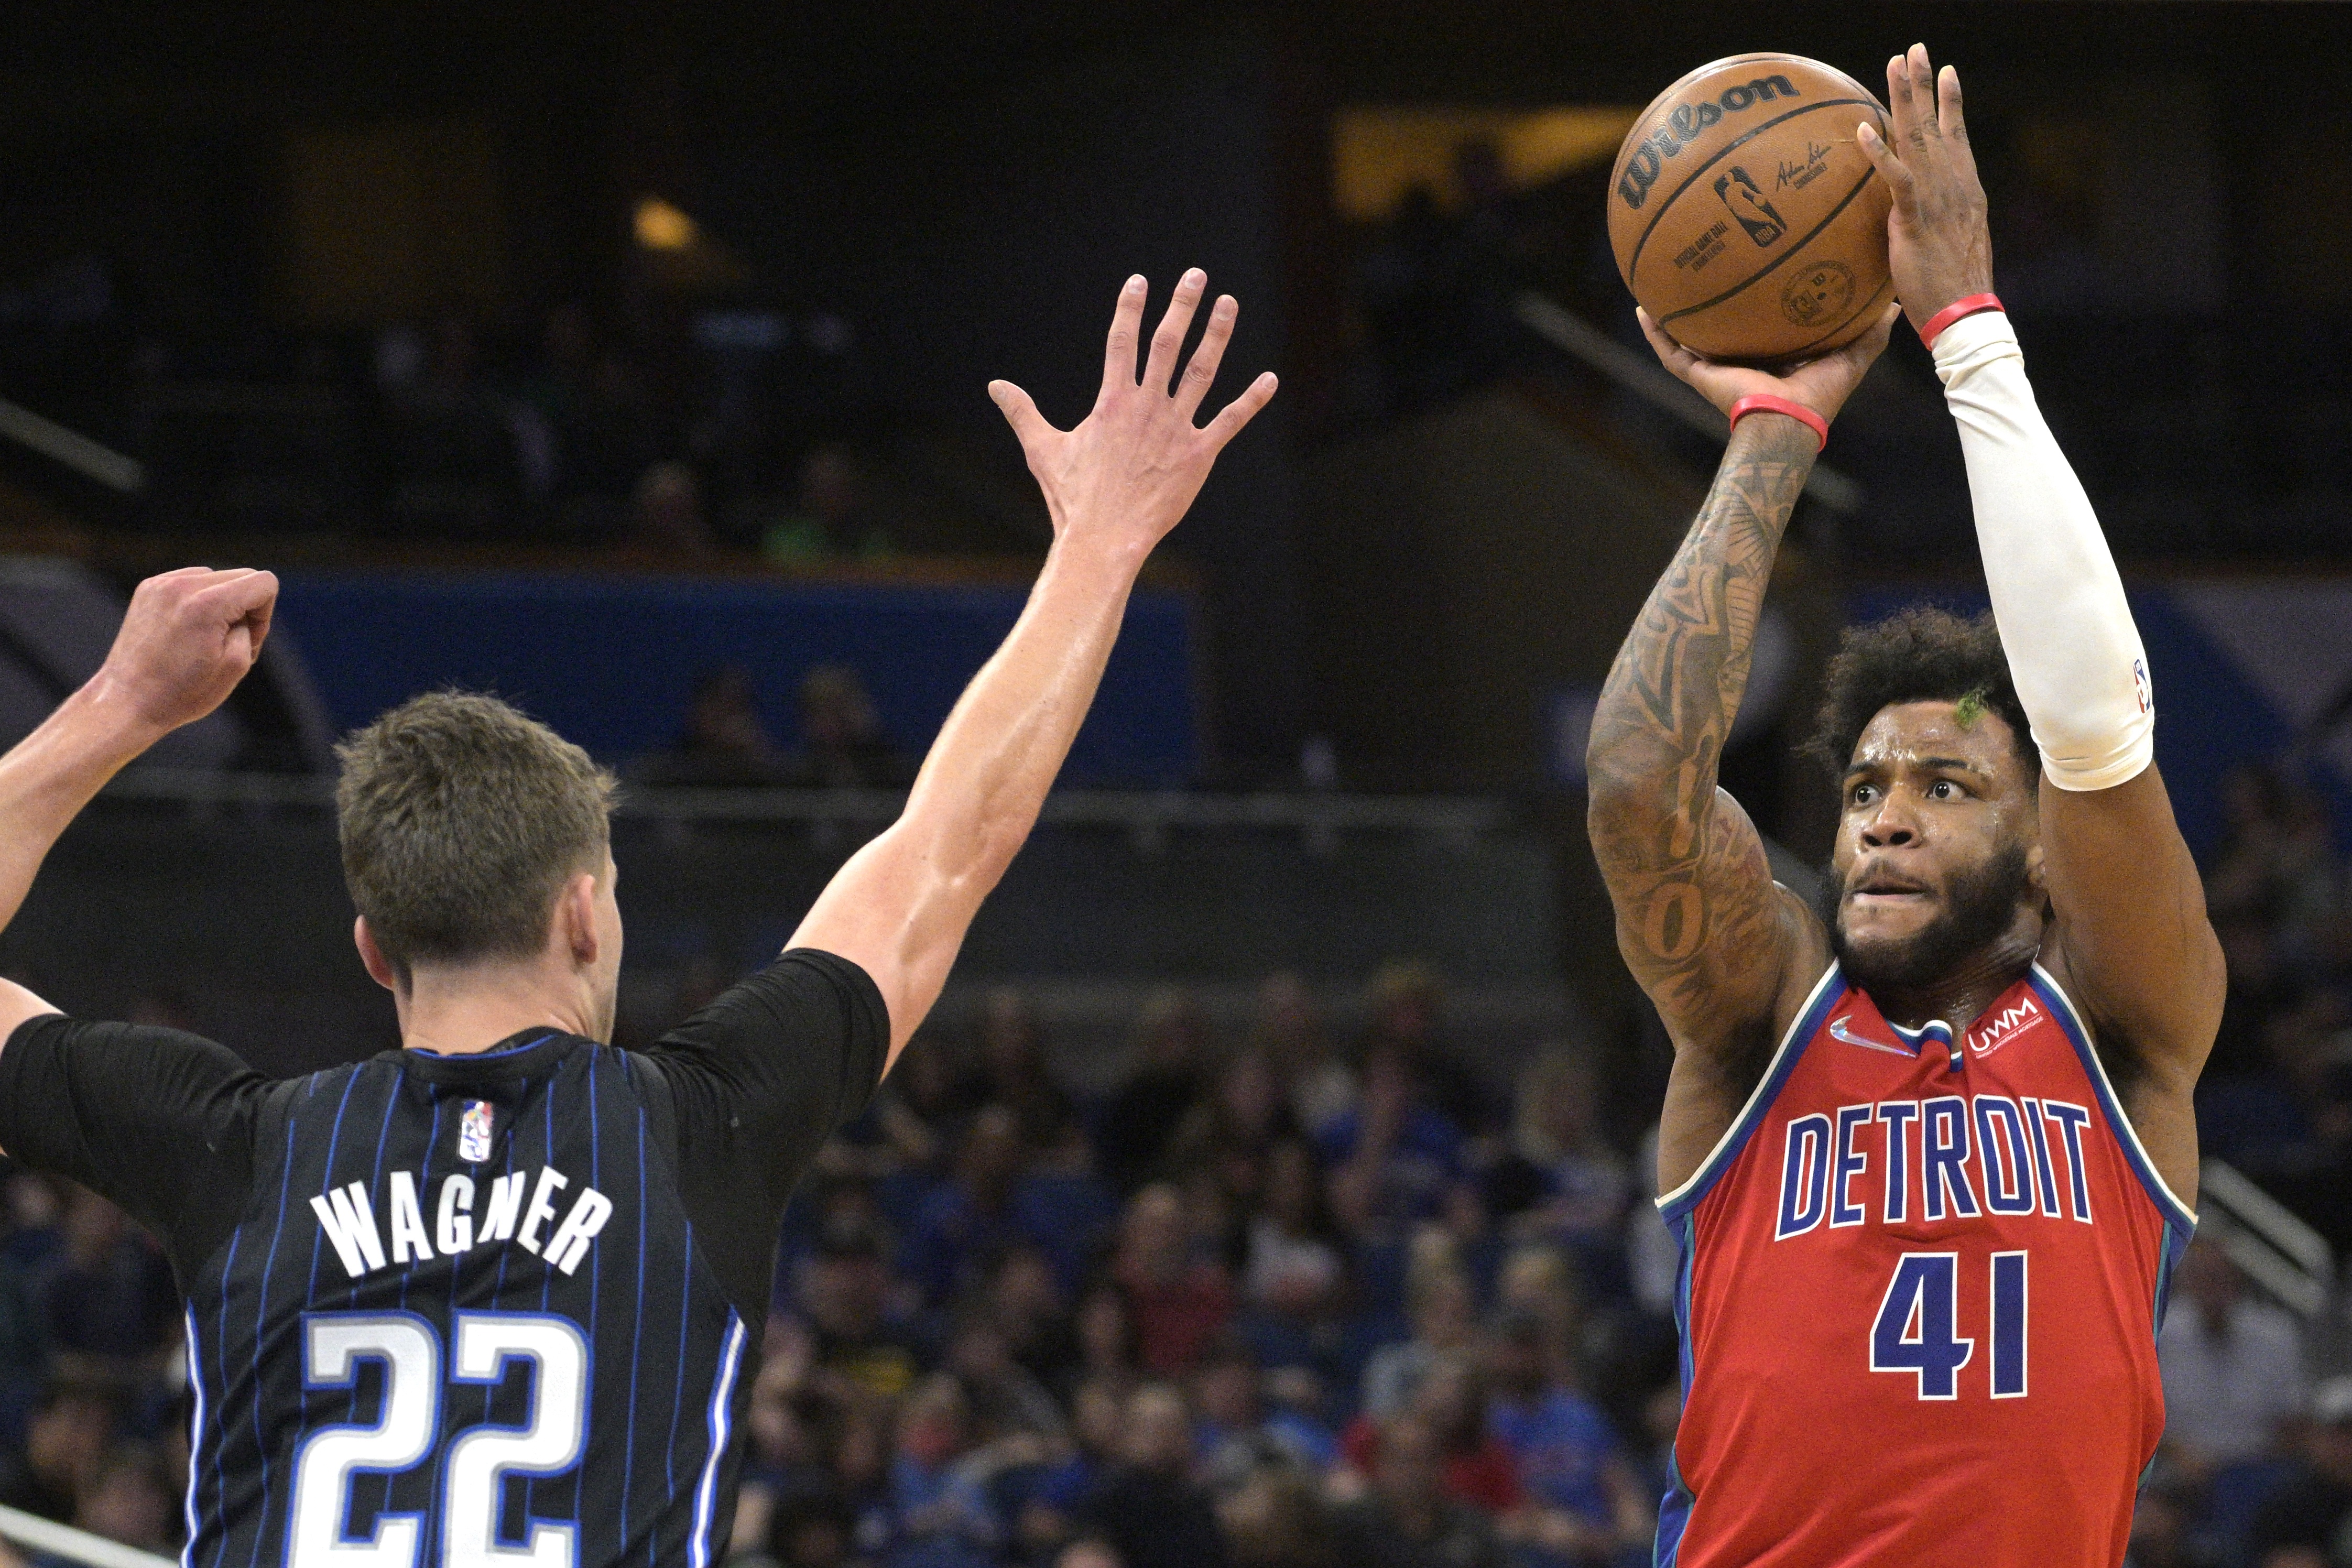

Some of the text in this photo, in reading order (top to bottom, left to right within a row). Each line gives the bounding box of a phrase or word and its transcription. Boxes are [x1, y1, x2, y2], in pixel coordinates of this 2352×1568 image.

[1618, 74, 1800, 209] Wilson
[1755, 225, 1777, 244] NBA
[1968, 997, 2038, 1052] UWM
[1976, 1016, 2043, 1059] UNITED WHOLESALE MORTGAGE
[309, 1165, 612, 1278] WAGNER
[1774, 1094, 2093, 1243] DETROIT
[1869, 1249, 2028, 1400] 41
[281, 1308, 594, 1568] 22
